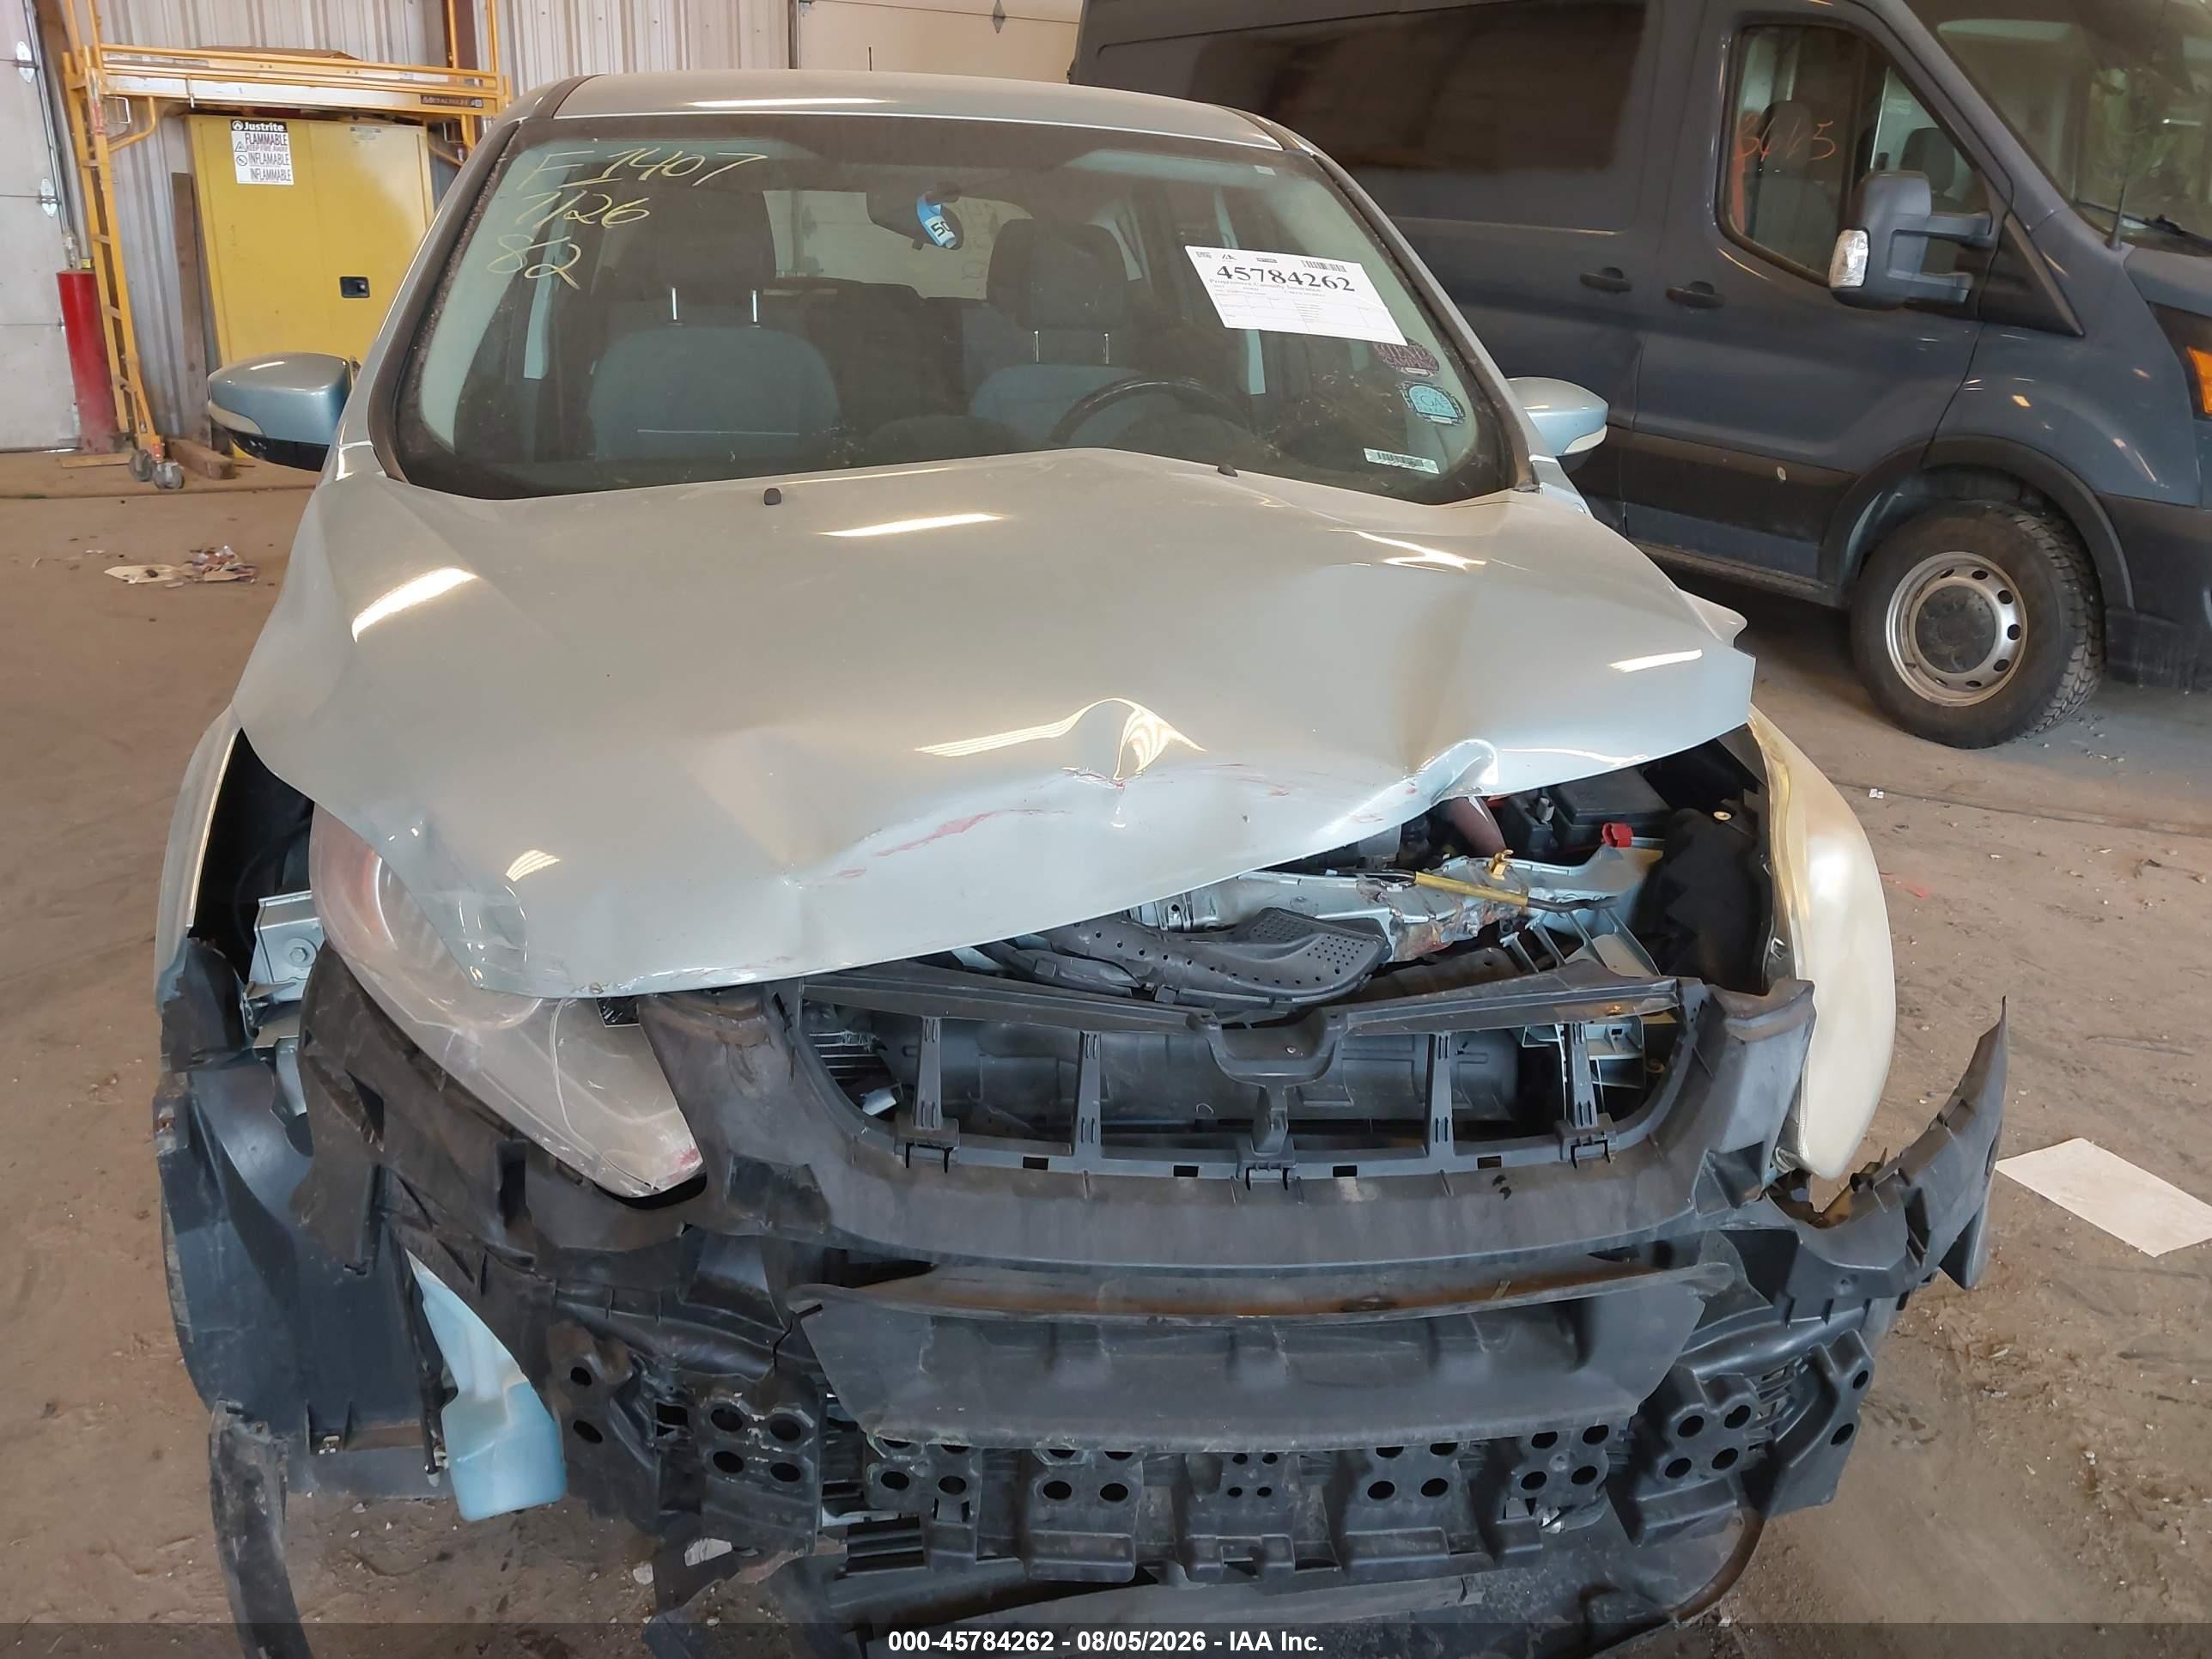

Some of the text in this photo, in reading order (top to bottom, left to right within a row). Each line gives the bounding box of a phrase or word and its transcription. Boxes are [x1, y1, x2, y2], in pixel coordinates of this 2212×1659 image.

[243, 122, 285, 131] Justrite
[245, 132, 288, 146] FLAMMABLE
[247, 152, 290, 166] INFLAMABLE
[250, 168, 292, 181] INFLAMMABLE
[487, 234, 580, 290] 82
[1217, 265, 1355, 292] 45784262
